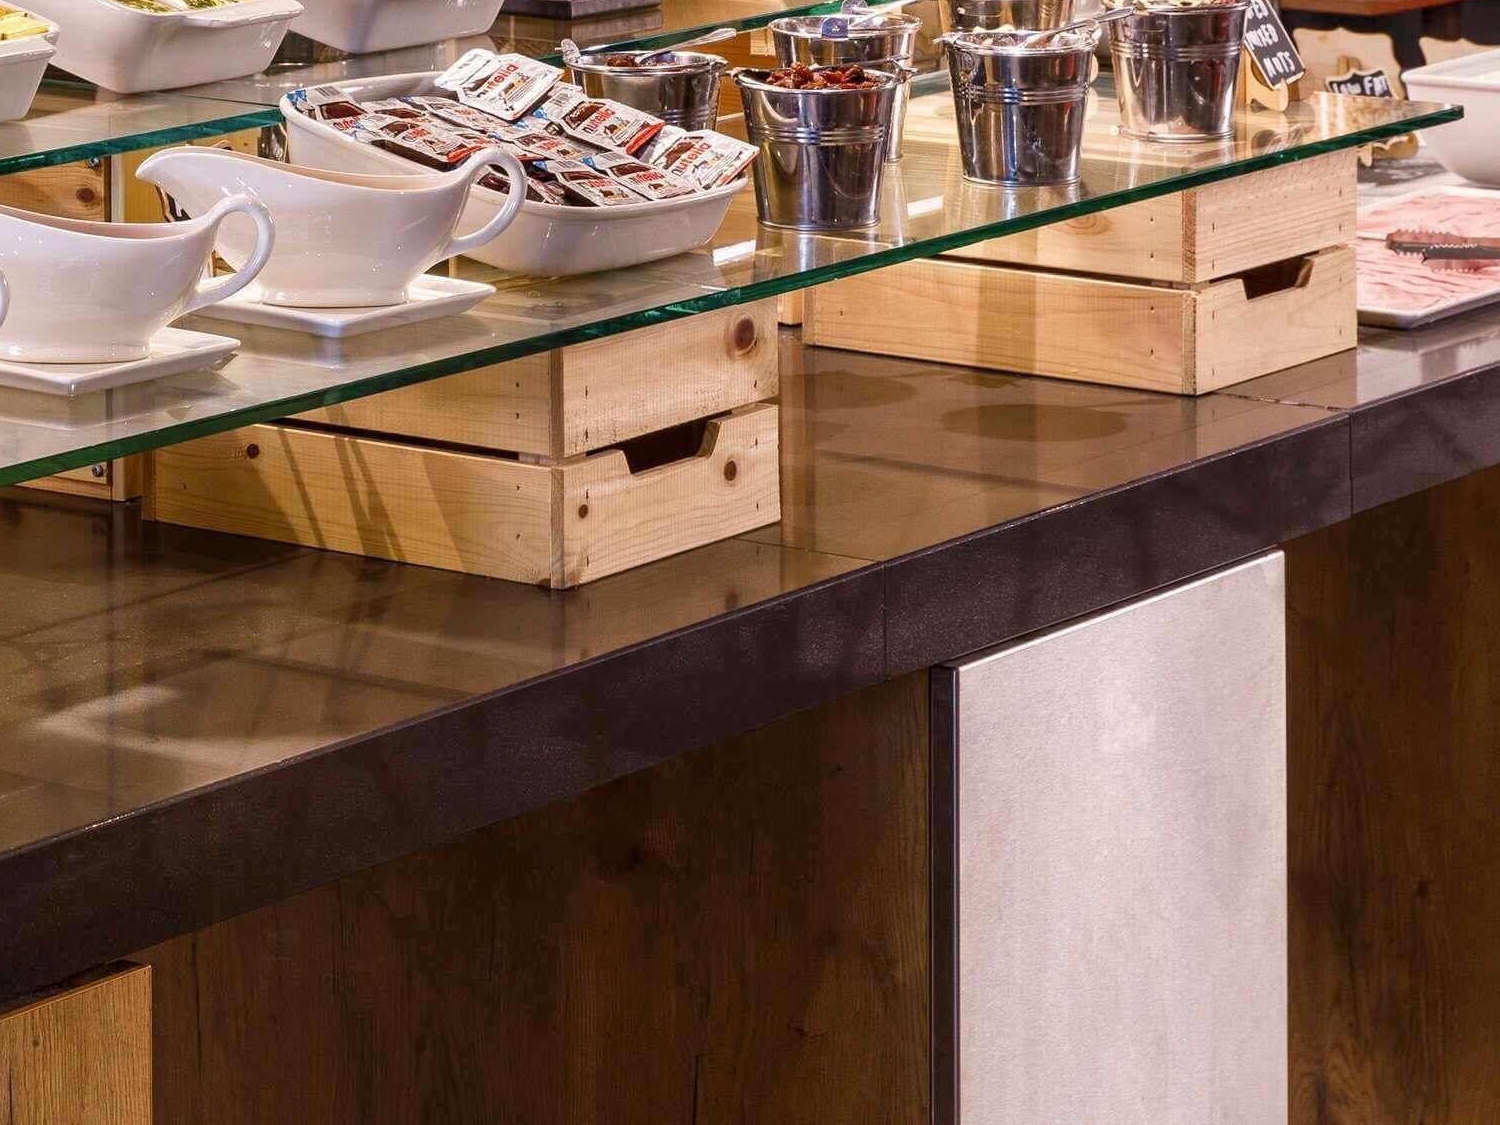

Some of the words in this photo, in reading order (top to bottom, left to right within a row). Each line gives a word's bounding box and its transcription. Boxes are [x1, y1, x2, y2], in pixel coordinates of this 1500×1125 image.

[476, 63, 519, 98] nutella
[582, 108, 616, 135] nutella
[671, 142, 712, 177] nutella
